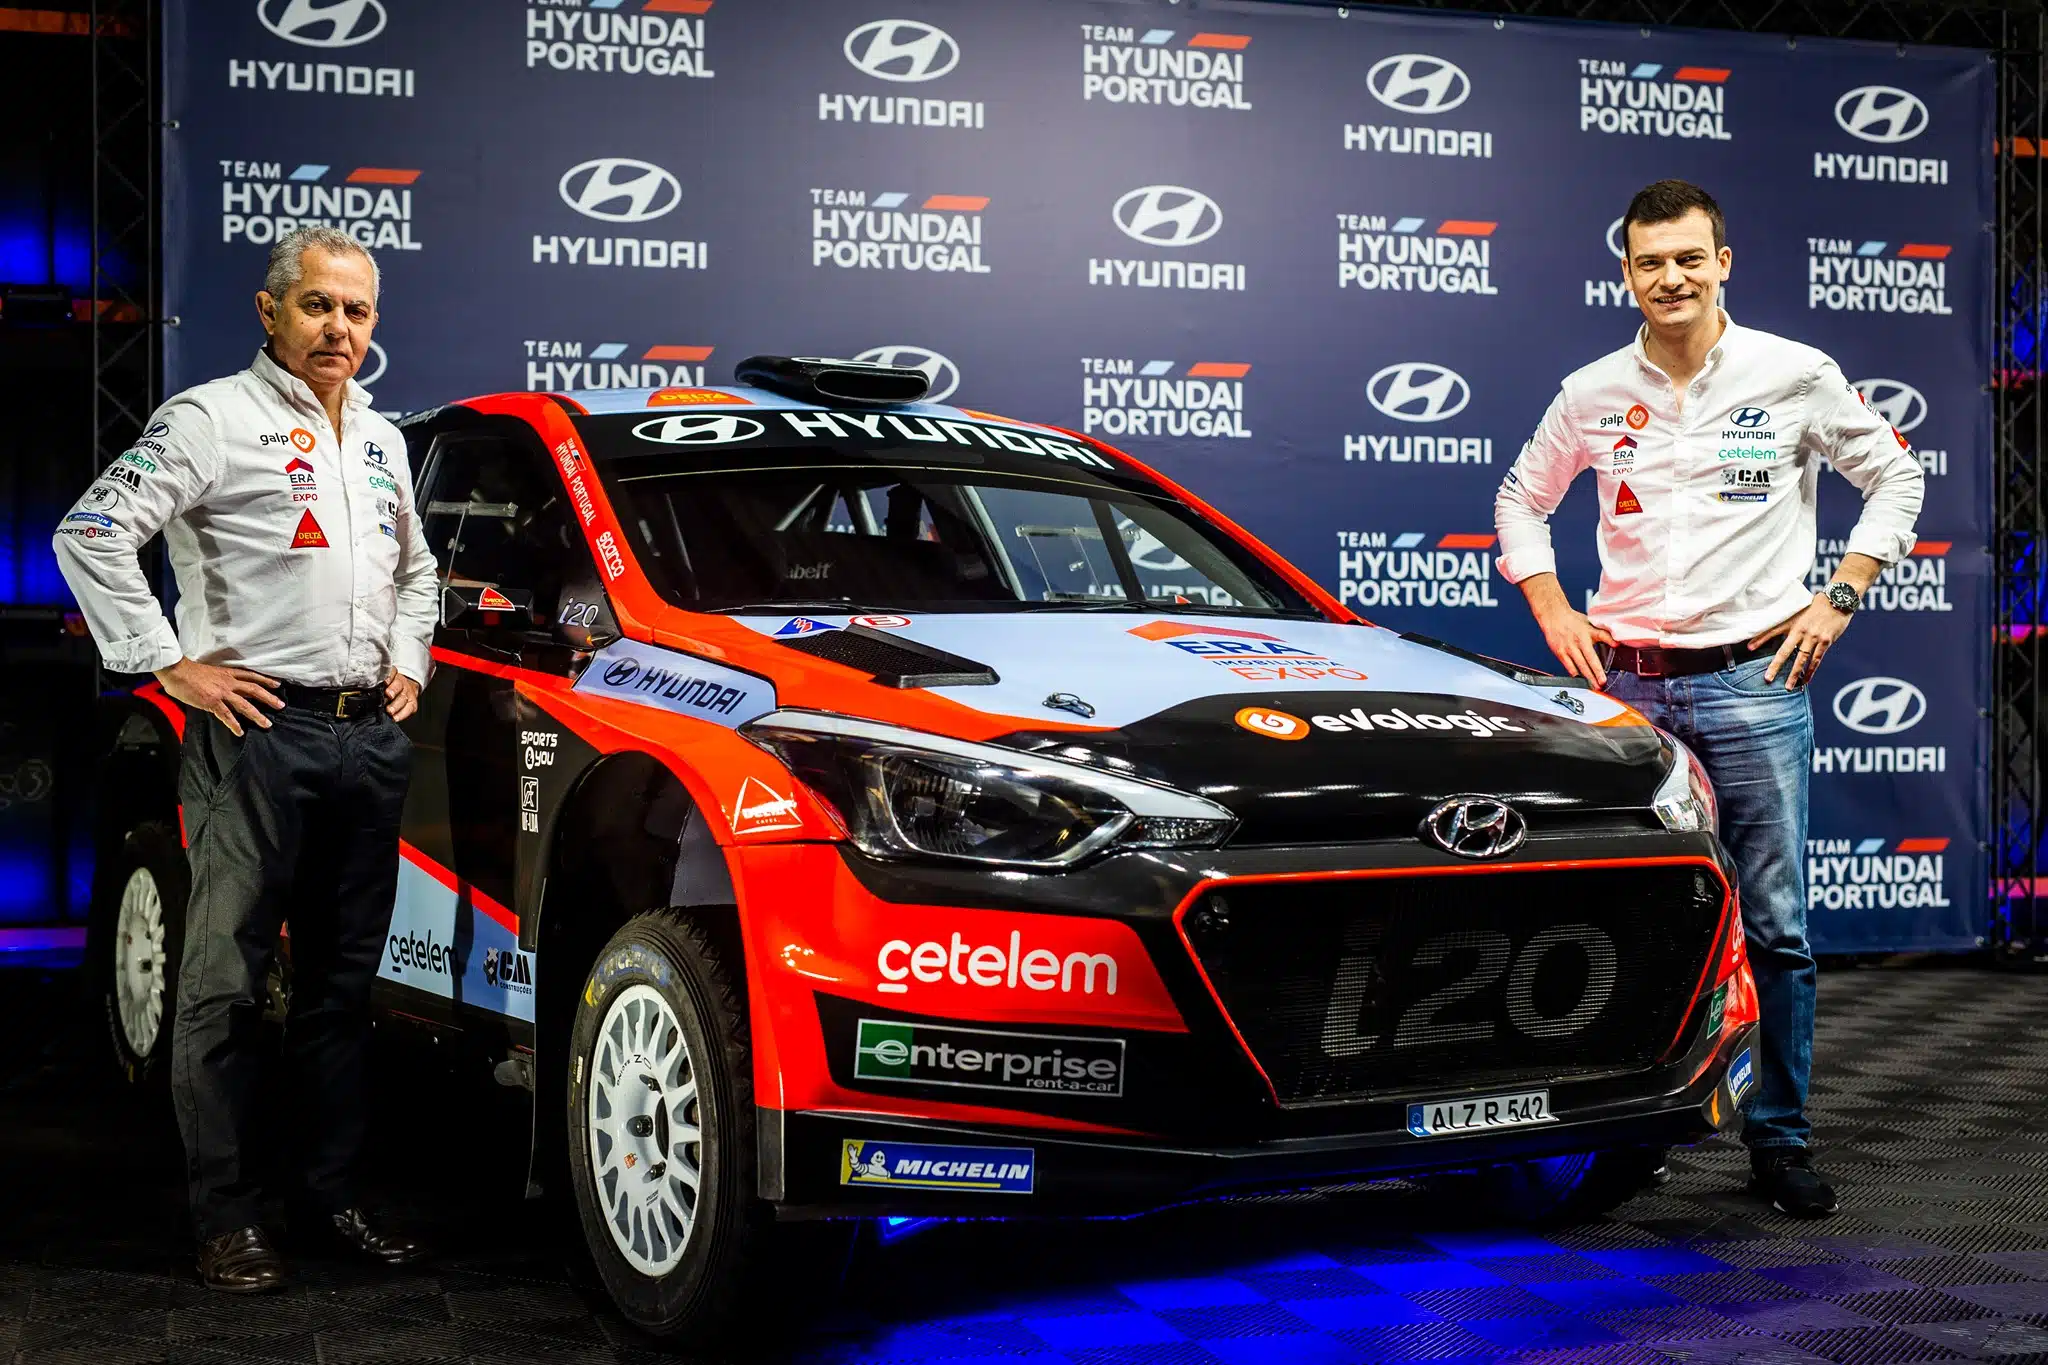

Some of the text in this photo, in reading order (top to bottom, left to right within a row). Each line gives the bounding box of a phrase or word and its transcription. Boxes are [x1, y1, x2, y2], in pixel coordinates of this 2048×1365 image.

[527, 9, 704, 48] HYUNDAI
[1082, 25, 1133, 43] TEAM
[527, 41, 714, 78] PORTUGAL
[1084, 45, 1243, 82] HYUNDAI
[1579, 59, 1625, 76] TEAM
[229, 59, 414, 97] HYUNDAI
[1084, 75, 1252, 110] PORTUGAL
[1581, 78, 1723, 113] HYUNDAI
[819, 93, 984, 128] HYUNDAI
[1581, 107, 1731, 140] PORTUGAL
[1345, 124, 1492, 157] HYUNDAI
[220, 160, 281, 179] TEAM
[1815, 153, 1948, 185] HYUNDAI
[223, 182, 411, 220] HYUNDAI
[811, 188, 865, 207] TEAM
[813, 210, 981, 245] HYUNDAI
[1337, 214, 1386, 232] TEAM
[533, 235, 707, 269] HYUNDAI
[813, 240, 991, 273] PORTUGAL
[1339, 233, 1489, 267] HYUNDAI
[1807, 238, 1852, 255] TEAM
[1089, 259, 1245, 290] HYUNDAI
[1339, 263, 1498, 295] PORTUGAL
[1810, 256, 1944, 289] HYUNDAI
[1810, 284, 1952, 315] PORTUGAL
[524, 341, 581, 359] TEAM
[527, 362, 704, 389] HYUNDAI
[1082, 358, 1133, 375] TEAM
[660, 393, 728, 401] DELTA
[1084, 377, 1242, 410] HYUNDAI
[1084, 407, 1251, 438] PORTUGAL
[1600, 414, 1624, 427] galp
[260, 433, 289, 445] galp
[780, 412, 1115, 470] HYUNDAI
[1722, 430, 1776, 440] HYUNDAI
[121, 450, 157, 474] telem
[1345, 435, 1492, 464] HYUNDAI
[1613, 450, 1634, 460] ERA
[1718, 446, 1777, 461] cetelem
[290, 474, 315, 483] ERA
[555, 442, 597, 527] HYUNDAI PORTUGAL
[1613, 467, 1633, 475] EXPO
[1738, 469, 1770, 483] CM
[293, 493, 318, 501] EXPO
[1619, 500, 1637, 508] DELTA
[75, 515, 109, 525] MICHELIN
[1337, 532, 1386, 548] TEAM
[1817, 539, 1849, 555] EAM
[599, 531, 625, 579] sparco
[1339, 551, 1490, 580] HYUNDAI
[786, 561, 834, 579] abelt
[1339, 580, 1498, 607] PORTUGAL
[558, 597, 599, 628] i20
[1165, 641, 1316, 656] ERA
[1228, 667, 1368, 681] EXPO
[637, 666, 748, 715] HYUNDAI
[1311, 708, 1526, 738] evologic
[521, 731, 558, 747] SPORTS
[1813, 747, 1945, 773] HYUNDAI
[1807, 839, 1851, 855] TEAM
[1808, 855, 1943, 885] HYUNDAI
[1808, 883, 1949, 910] PORTUGAL
[499, 951, 531, 985] CM
[877, 930, 1117, 995] cetelem
[873, 1037, 1117, 1081] enterprise
[1026, 1076, 1115, 1092] rent-a-car
[1432, 1096, 1548, 1131] ALZ R 542
[894, 1159, 1030, 1180] MICHELIN
